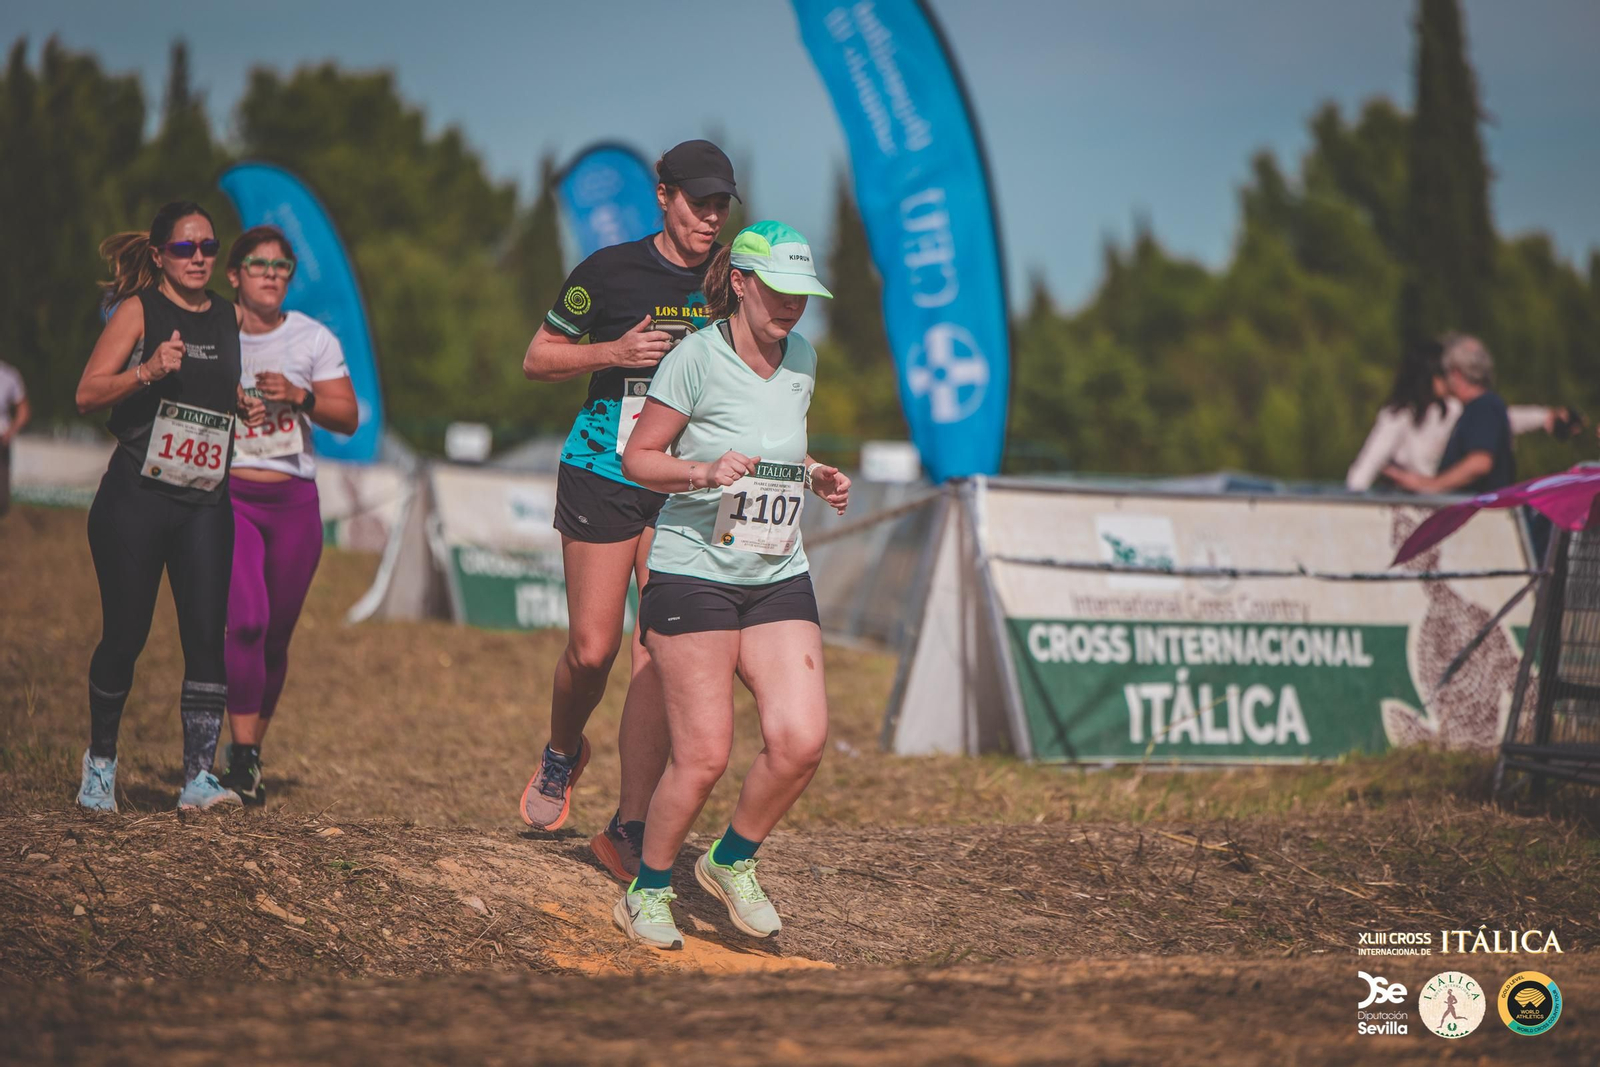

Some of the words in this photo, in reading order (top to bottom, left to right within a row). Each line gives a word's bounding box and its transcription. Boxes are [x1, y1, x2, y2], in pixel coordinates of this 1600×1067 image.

[789, 254, 810, 262] KIPRUN
[655, 306, 678, 317] LOS
[158, 432, 222, 471] 1483
[757, 463, 792, 478] ITÁLICA
[730, 491, 801, 526] 1107
[1028, 623, 1131, 663] CROSS
[1134, 626, 1374, 668] INTERNACIONAL
[1124, 667, 1311, 745] ITÁLICA
